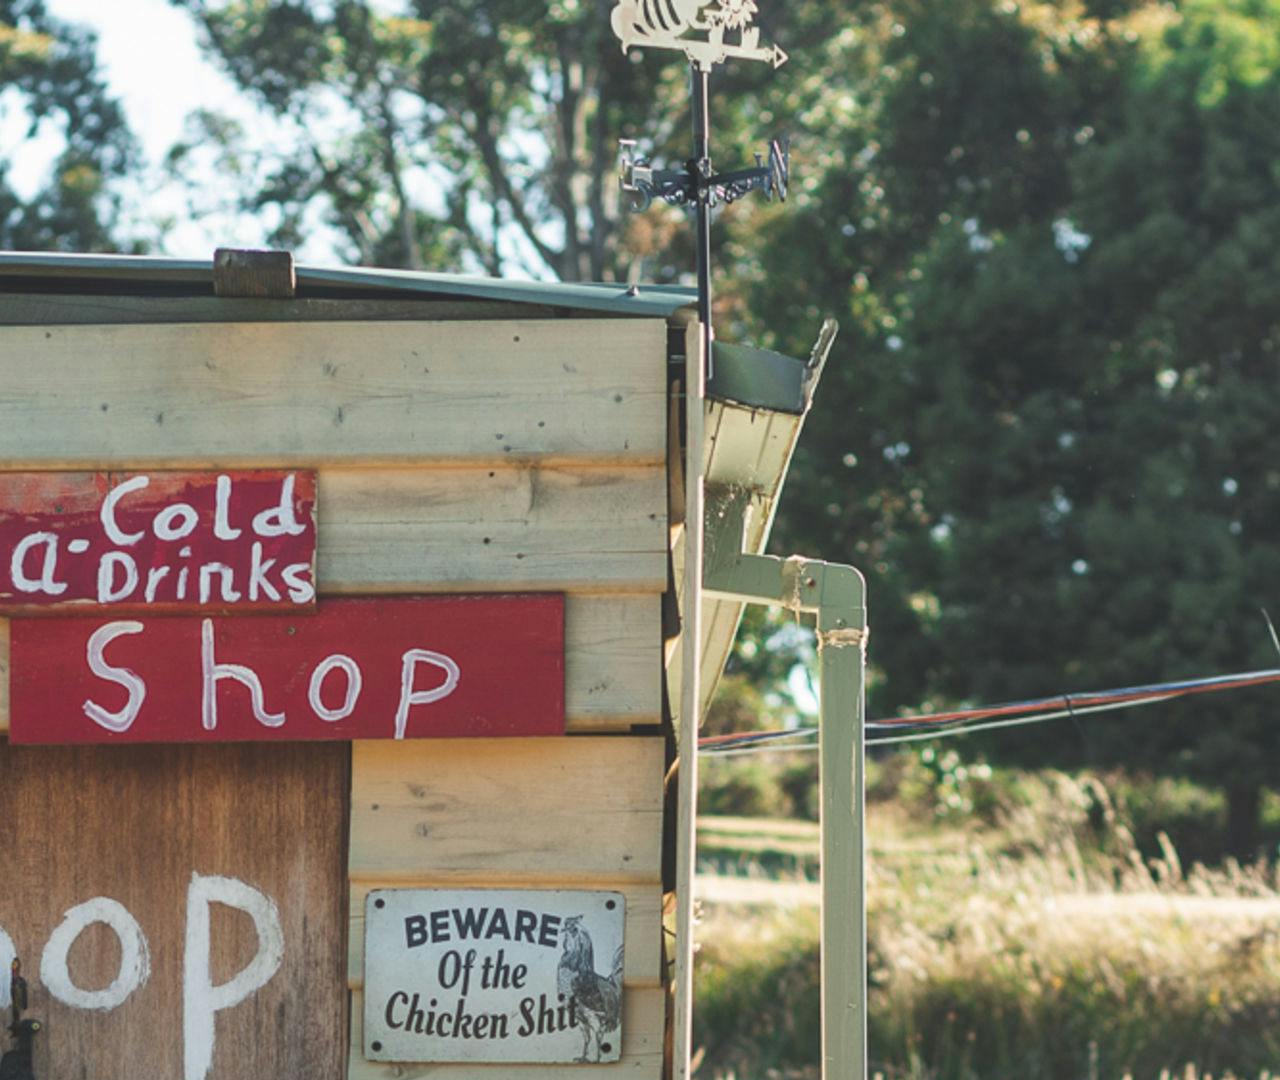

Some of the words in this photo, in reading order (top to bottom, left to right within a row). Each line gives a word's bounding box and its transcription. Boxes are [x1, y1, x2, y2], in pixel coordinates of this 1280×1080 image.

[100, 475, 306, 546] Cold
[97, 541, 315, 604] Drinks
[84, 620, 461, 740] Shop
[404, 908, 562, 949] BEWARE
[437, 949, 476, 996] Of
[482, 951, 528, 989] the
[385, 992, 508, 1040] Chicken
[518, 994, 580, 1038] Shit
